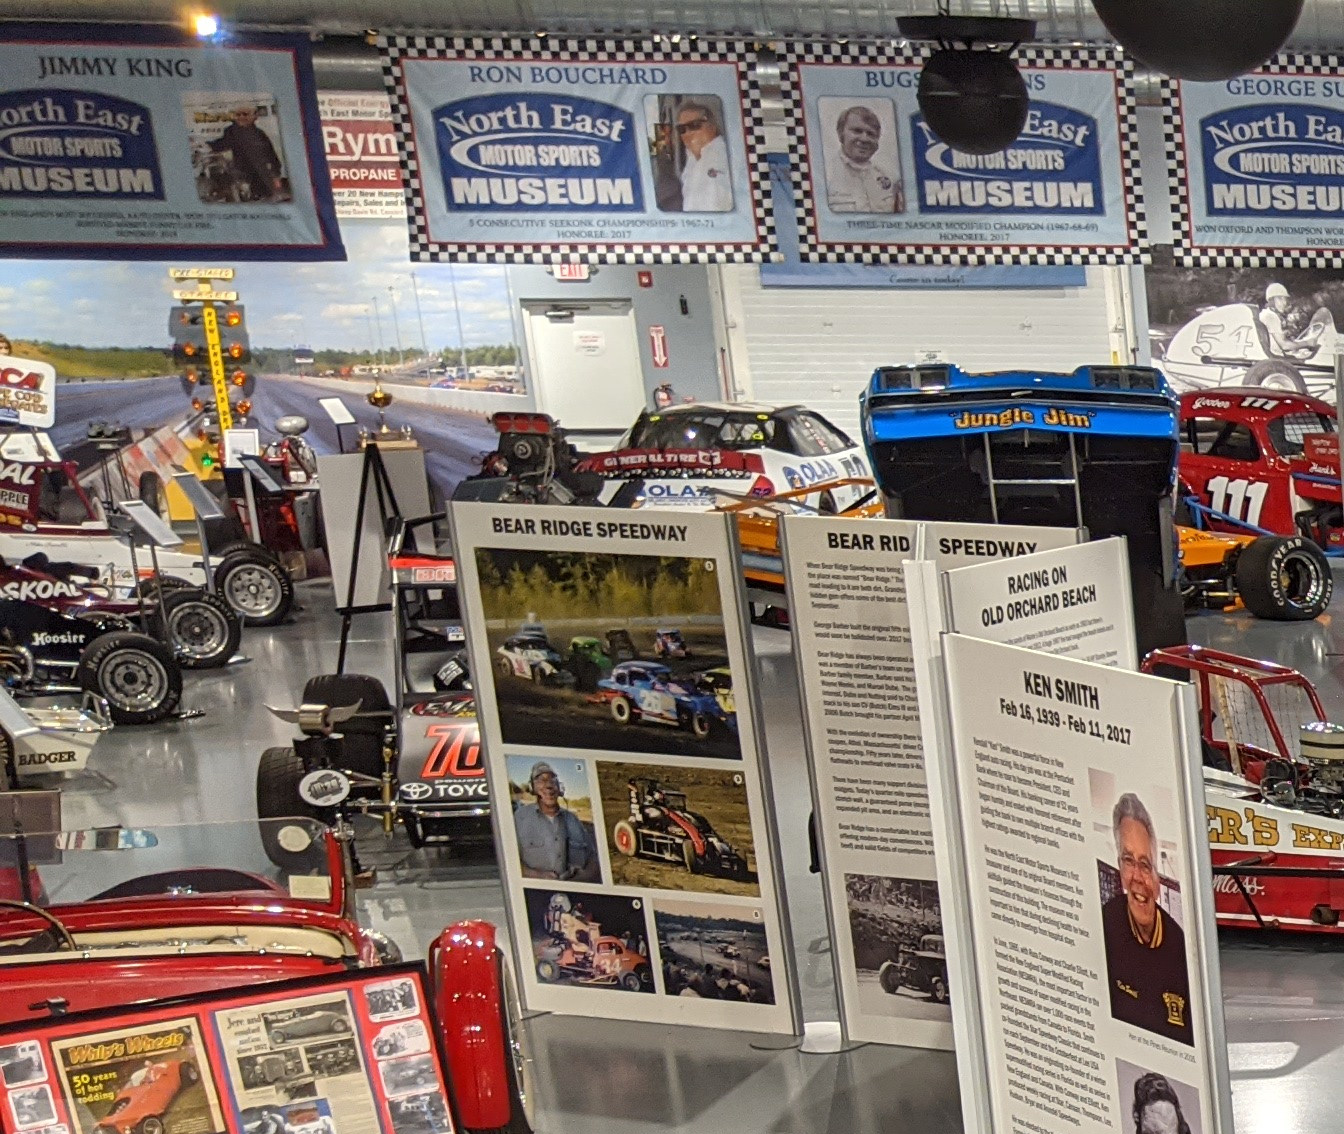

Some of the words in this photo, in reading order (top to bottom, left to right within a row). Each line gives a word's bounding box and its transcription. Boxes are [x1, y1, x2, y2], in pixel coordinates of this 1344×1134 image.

[38, 56, 117, 79] JIMMY
[129, 58, 193, 79] KING
[470, 65, 522, 84] RON
[531, 66, 667, 85] BOUCHARD
[865, 71, 921, 88] BUGS
[1226, 79, 1316, 97] GEORGE
[0, 98, 67, 127] orth
[76, 99, 144, 137] East
[440, 102, 541, 142] North
[550, 104, 626, 142] East
[1025, 111, 1090, 147] East
[1206, 112, 1298, 150] North
[10, 136, 64, 157] MOTOR
[65, 136, 122, 159] SPORTS
[322, 126, 399, 161] Rym
[479, 144, 537, 167] MOTOR
[538, 144, 600, 168] SPORTS
[1006, 149, 1065, 171] SPORTS
[1239, 152, 1291, 174] MOTOR
[0, 167, 154, 194] MUSEUM
[330, 168, 397, 180] PROPANE
[451, 177, 634, 205] MUSEUM
[924, 180, 1094, 208] MUSEUM
[560, 264, 584, 277] EXIT
[665, 453, 697, 465] TIRE
[1207, 476, 1268, 527] 111
[492, 517, 536, 534] BEAR
[541, 520, 593, 538] RIDGE
[596, 522, 687, 542] SPEEDWAY
[827, 532, 874, 550] BEAR
[879, 534, 910, 551] RID
[939, 538, 1037, 557] SPEEDWAY
[1008, 570, 1049, 594] RACING
[1051, 566, 1067, 584] ON
[1271, 538, 1302, 606] GOODYEAR
[3, 581, 83, 600] SKOAL
[981, 606, 1004, 627] OLD
[1007, 592, 1060, 621] ORCHARD
[1062, 584, 1097, 610] BEACH
[32, 631, 86, 646] Hoosier
[1023, 671, 1052, 699] KEN
[1055, 678, 1100, 710] SMITH
[1000, 698, 1018, 717] Feb
[1020, 702, 1035, 725] 16,
[1037, 705, 1060, 727] 1939
[1068, 713, 1086, 734] Feb
[1089, 720, 1105, 742] 11,
[1106, 723, 1131, 745] 2017
[18, 750, 76, 766] BADGER
[435, 784, 488, 796] TOYO
[73, 1073, 91, 1088] 50
[92, 1071, 117, 1084] years
[75, 1087, 86, 1096] of
[87, 1083, 104, 1093] hot
[78, 1091, 115, 1104] rodding
